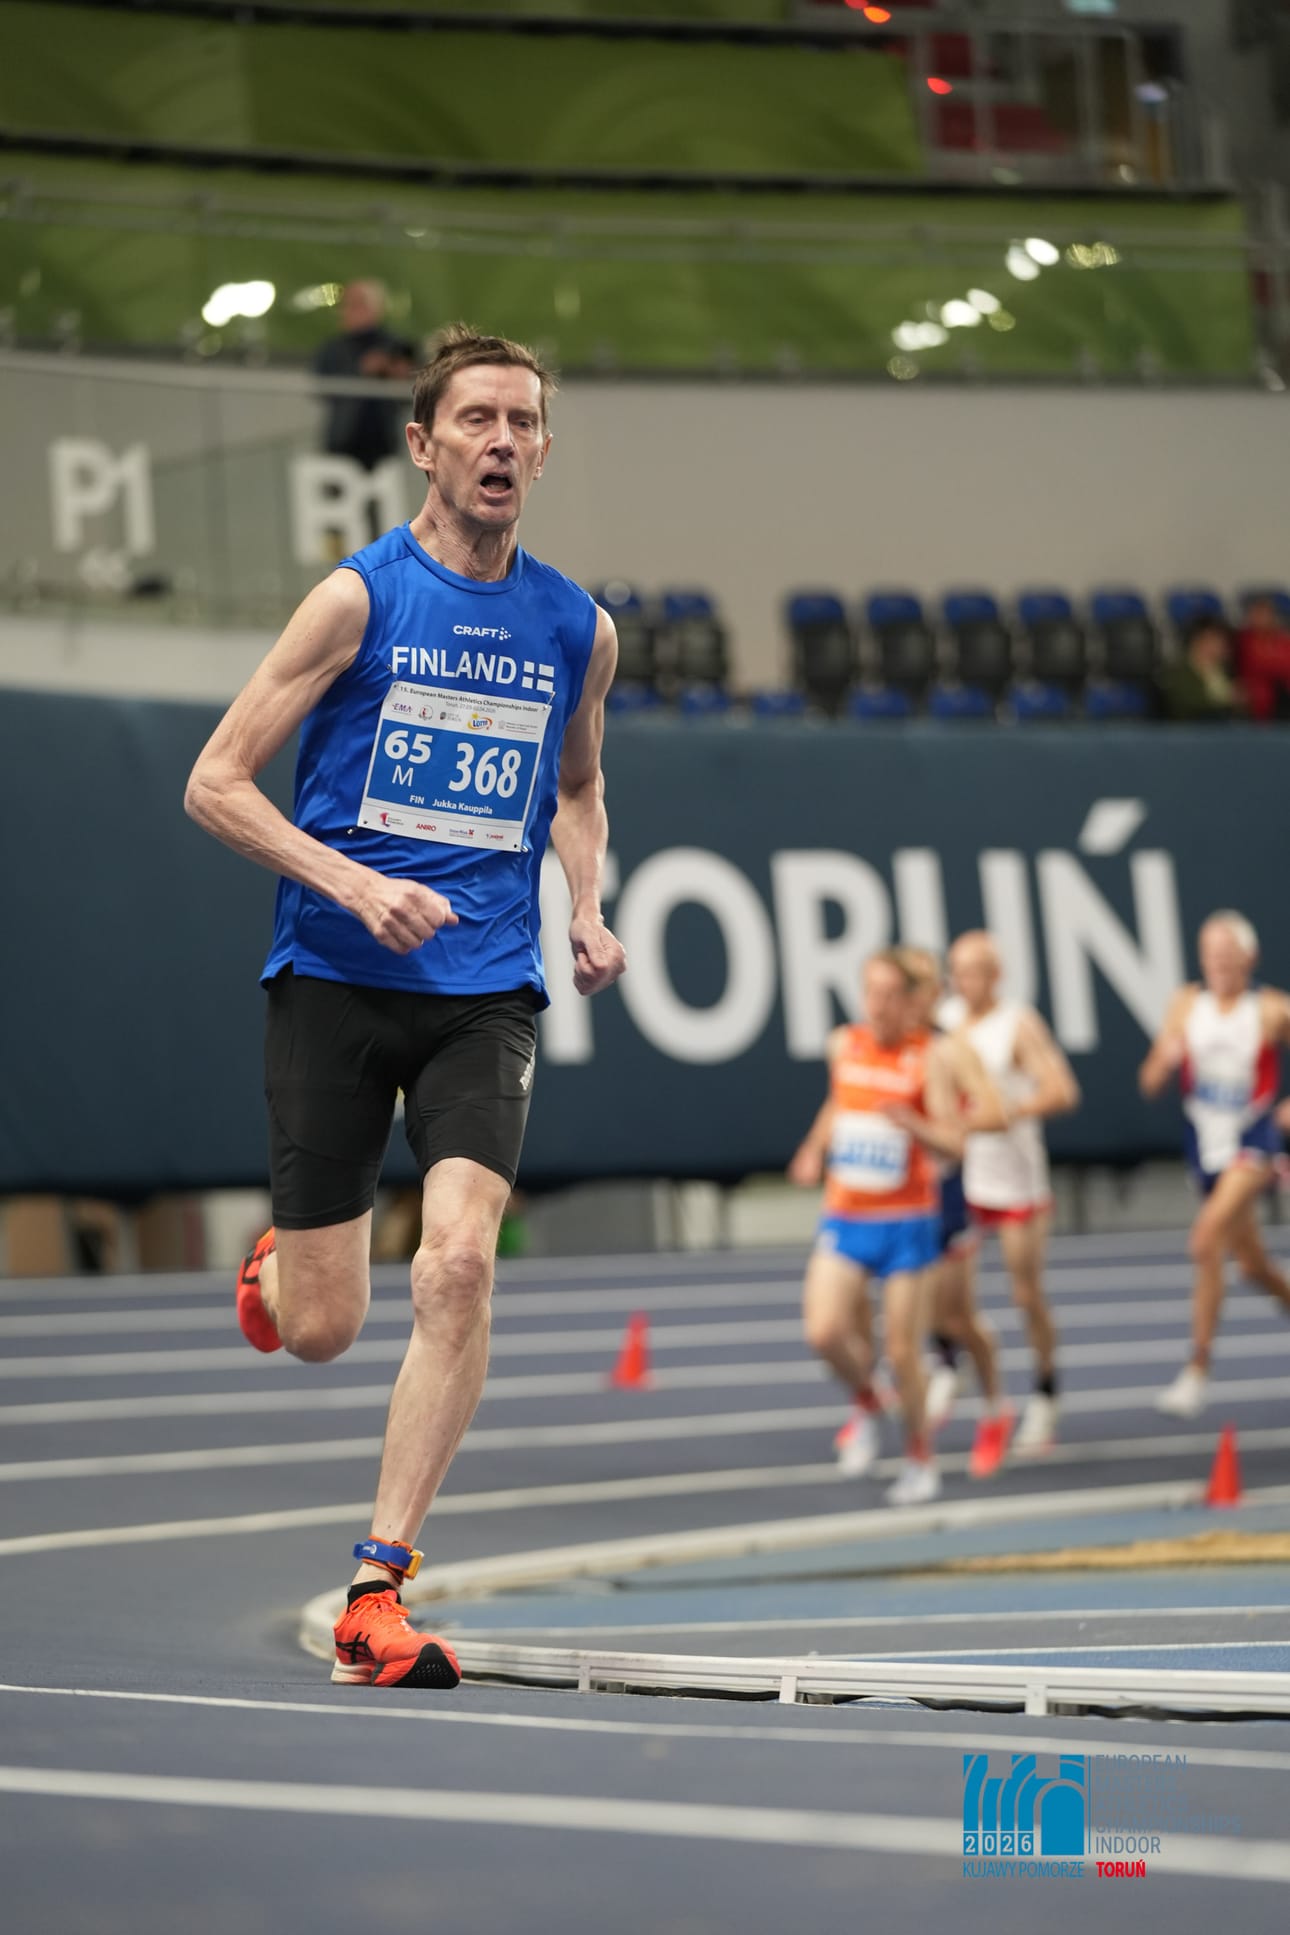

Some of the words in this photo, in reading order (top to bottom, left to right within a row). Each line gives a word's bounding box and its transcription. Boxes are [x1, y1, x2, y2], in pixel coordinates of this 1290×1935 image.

[48, 436, 154, 555] P1
[453, 625, 498, 639] CRAFT
[391, 646, 518, 685] FINLAND
[410, 688, 437, 697] European
[438, 693, 458, 701] Masters
[459, 695, 482, 705] Athletics
[384, 729, 433, 764] 65
[448, 742, 522, 799] 368
[391, 765, 414, 787] M
[409, 794, 425, 805] FIN
[432, 798, 457, 811] Jukka
[458, 802, 493, 815] Kauppila
